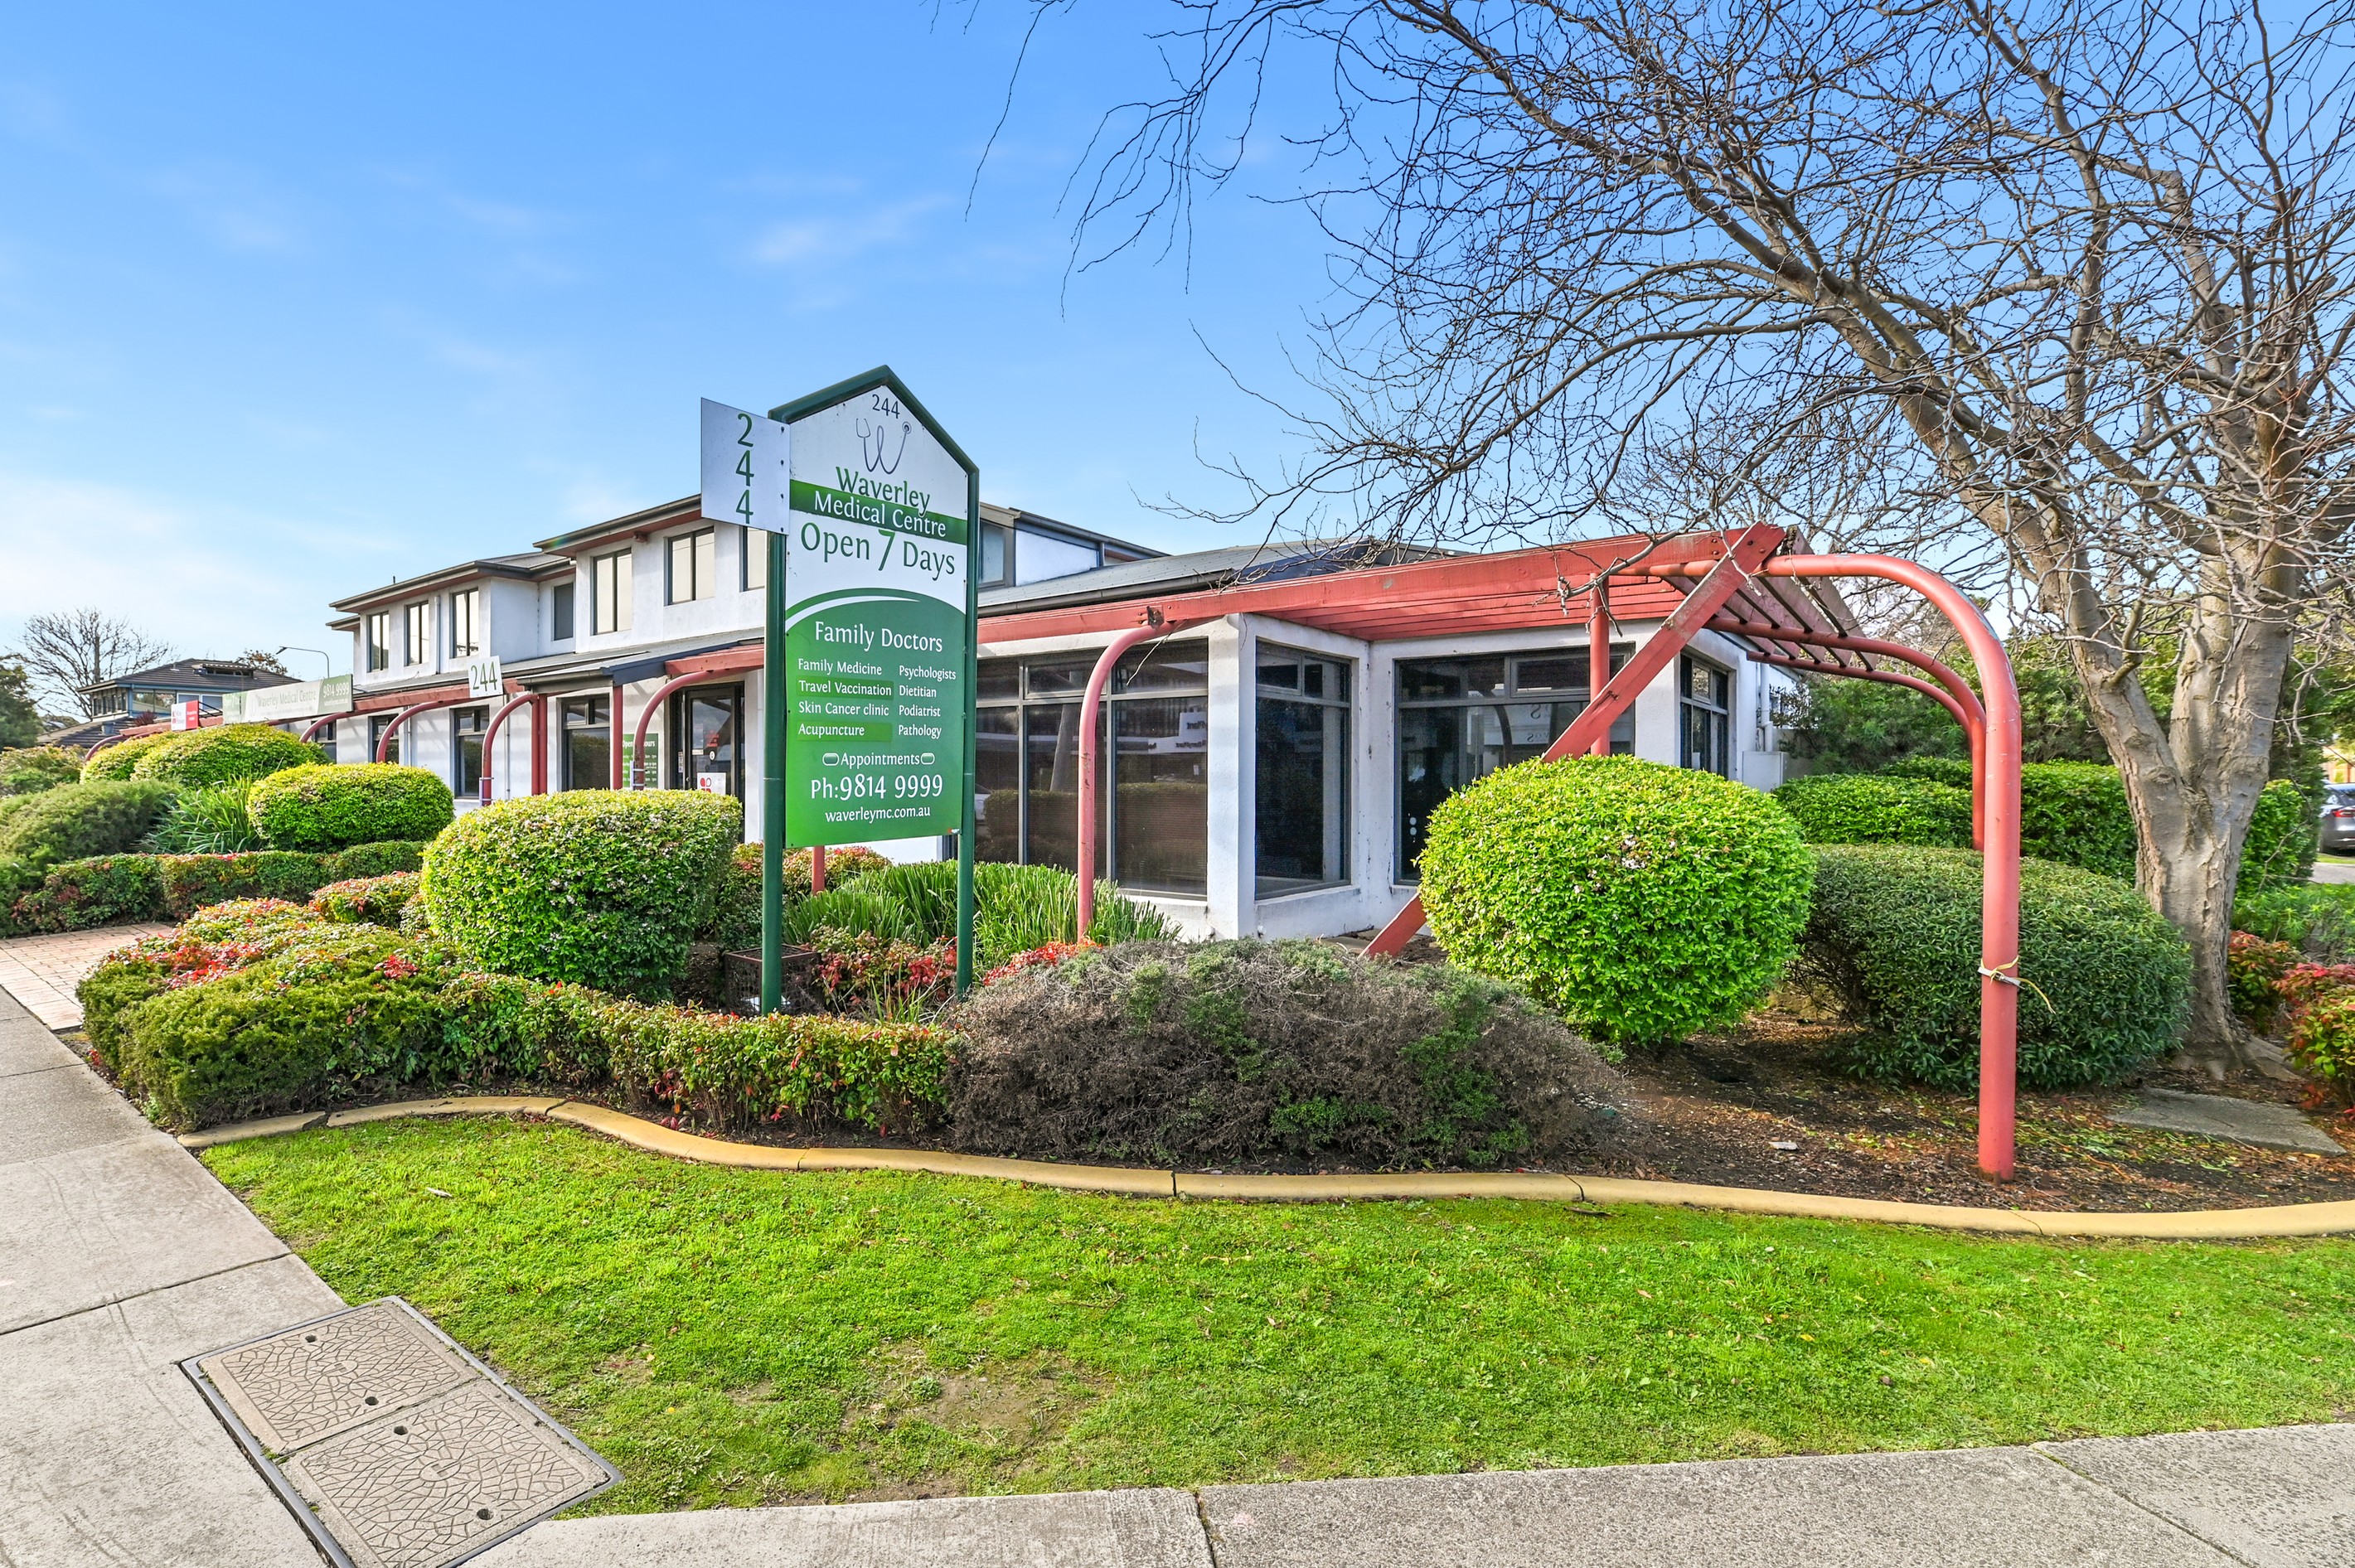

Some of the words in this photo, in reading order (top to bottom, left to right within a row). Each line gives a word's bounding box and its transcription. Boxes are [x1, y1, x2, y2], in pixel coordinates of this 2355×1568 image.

[872, 394, 900, 419] 244
[735, 413, 754, 525] 244
[836, 467, 931, 514] Waverley
[815, 491, 885, 525] Medical
[892, 508, 947, 537] Centre
[801, 522, 870, 563] Open
[878, 529, 895, 571] 7
[904, 541, 955, 580] Days
[815, 621, 875, 651] Family
[881, 628, 942, 652] Doctors
[798, 658, 833, 675] Family
[836, 661, 882, 675] Medicine
[899, 665, 957, 682] Psychologists
[470, 661, 497, 692] 244
[336, 682, 349, 696] 9999
[798, 680, 831, 693] Travel
[835, 682, 892, 696] Vaccination
[899, 685, 937, 698] Dietitian
[279, 690, 298, 704] Medical
[299, 690, 317, 702] Centre
[798, 700, 821, 714] Skin
[825, 703, 860, 715] Cancer
[863, 704, 889, 716] clinic
[899, 705, 941, 717] Podiatrist
[798, 724, 865, 738] Acupuncture
[898, 724, 942, 739] Pathology
[841, 752, 920, 770] Appointments
[894, 774, 942, 799] 9999
[825, 806, 930, 824] waverleymc.com.au
